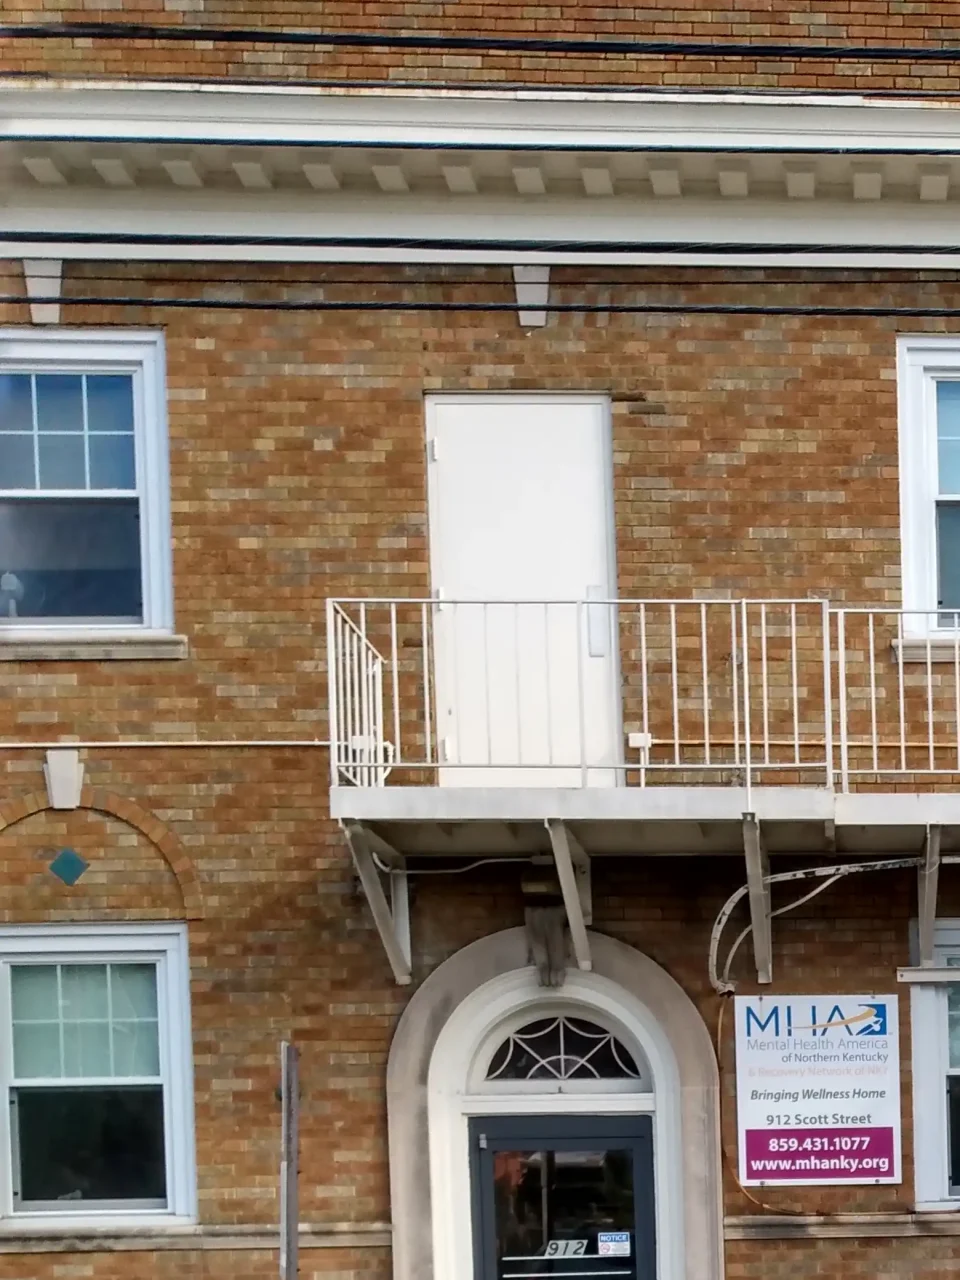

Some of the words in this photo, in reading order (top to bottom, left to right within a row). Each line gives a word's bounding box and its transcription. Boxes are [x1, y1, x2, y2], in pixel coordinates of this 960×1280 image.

[746, 1003, 854, 1037] MHA
[747, 1038, 790, 1051] Mental
[793, 1037, 834, 1050] Health
[838, 1037, 888, 1050] America
[781, 1052, 794, 1062] of
[795, 1052, 840, 1062] Northern
[842, 1052, 889, 1064] Kentucky
[758, 1067, 806, 1079] Recovery
[810, 1066, 852, 1076] Network
[854, 1065, 866, 1076] of
[750, 1089, 799, 1103] Bringing
[802, 1089, 850, 1100] Wellness
[852, 1088, 886, 1099] Home
[766, 1114, 791, 1126] 912
[794, 1113, 829, 1126] Scott
[832, 1113, 872, 1125] Street
[768, 1136, 871, 1152] 859.431.1077
[751, 1156, 889, 1172] www.mhanky.org
[600, 1234, 627, 1242] NOTICE
[548, 1241, 584, 1256] 912
